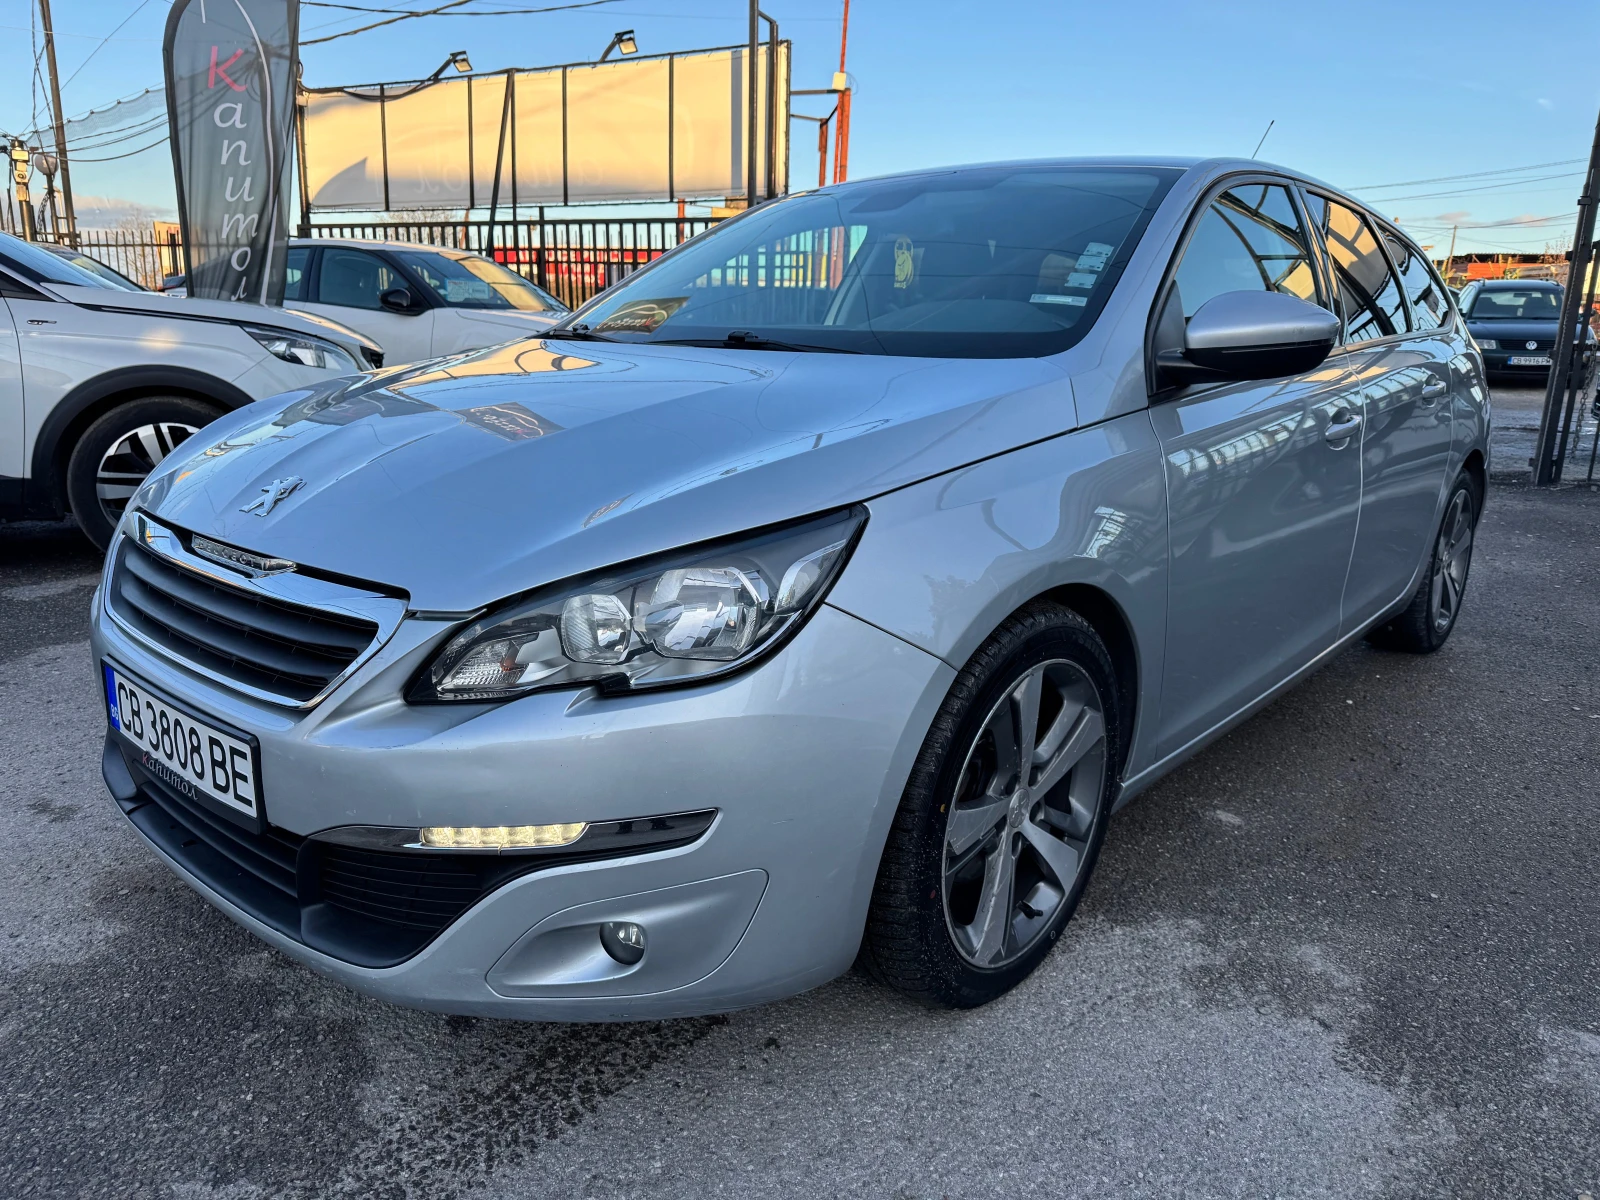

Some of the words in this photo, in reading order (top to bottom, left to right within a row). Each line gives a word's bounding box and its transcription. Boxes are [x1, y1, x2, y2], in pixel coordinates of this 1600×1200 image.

[110, 703, 119, 721] BG
[117, 681, 144, 741] CB
[145, 700, 205, 781] 3808
[208, 734, 253, 808] BE
